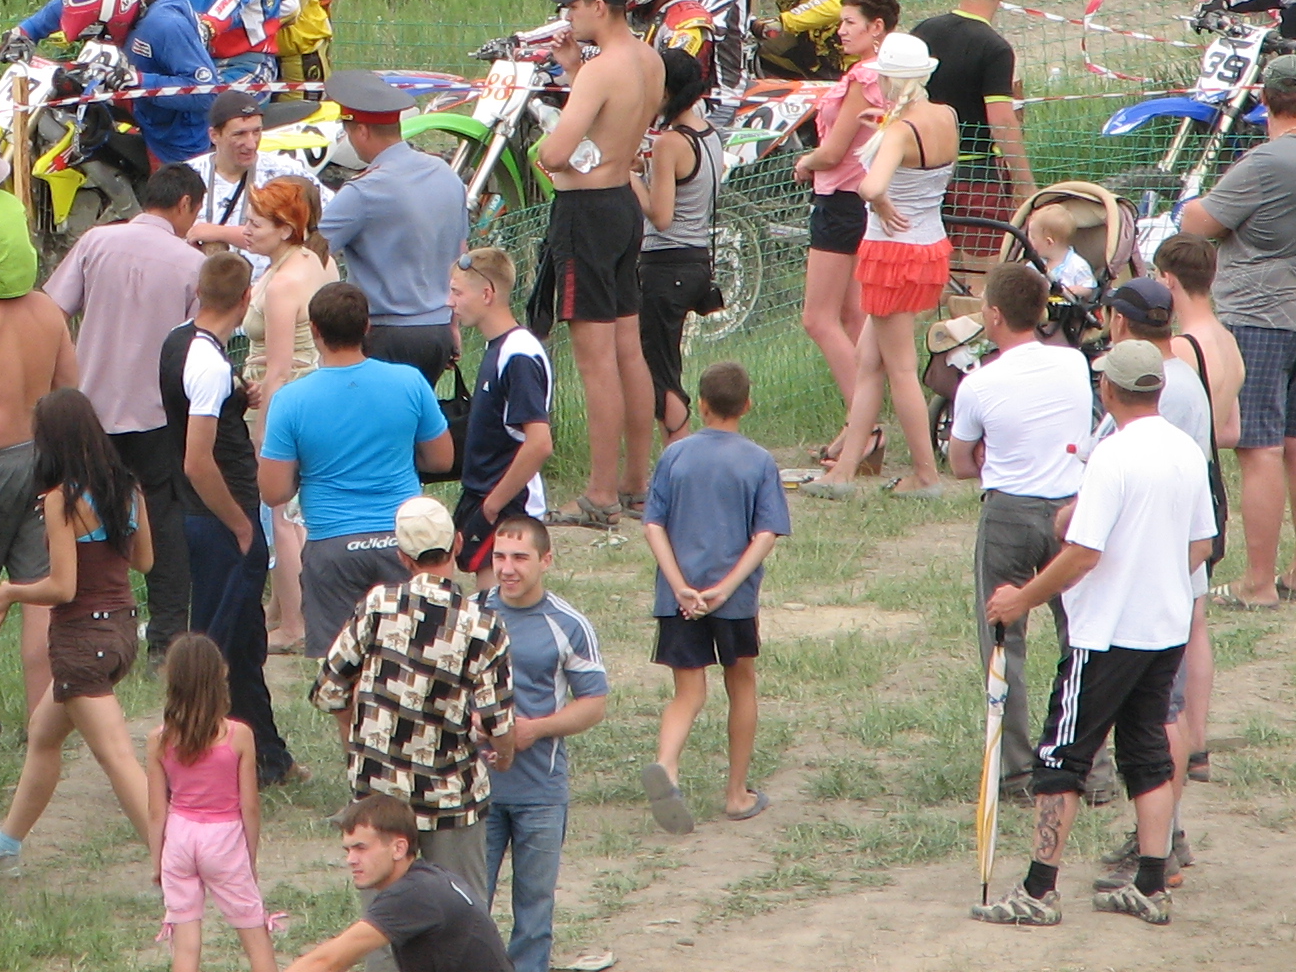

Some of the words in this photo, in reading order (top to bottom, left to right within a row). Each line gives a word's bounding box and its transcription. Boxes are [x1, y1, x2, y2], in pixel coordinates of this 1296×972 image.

[1201, 51, 1252, 86] 39
[480, 73, 516, 101] 88
[347, 536, 399, 551] adida
